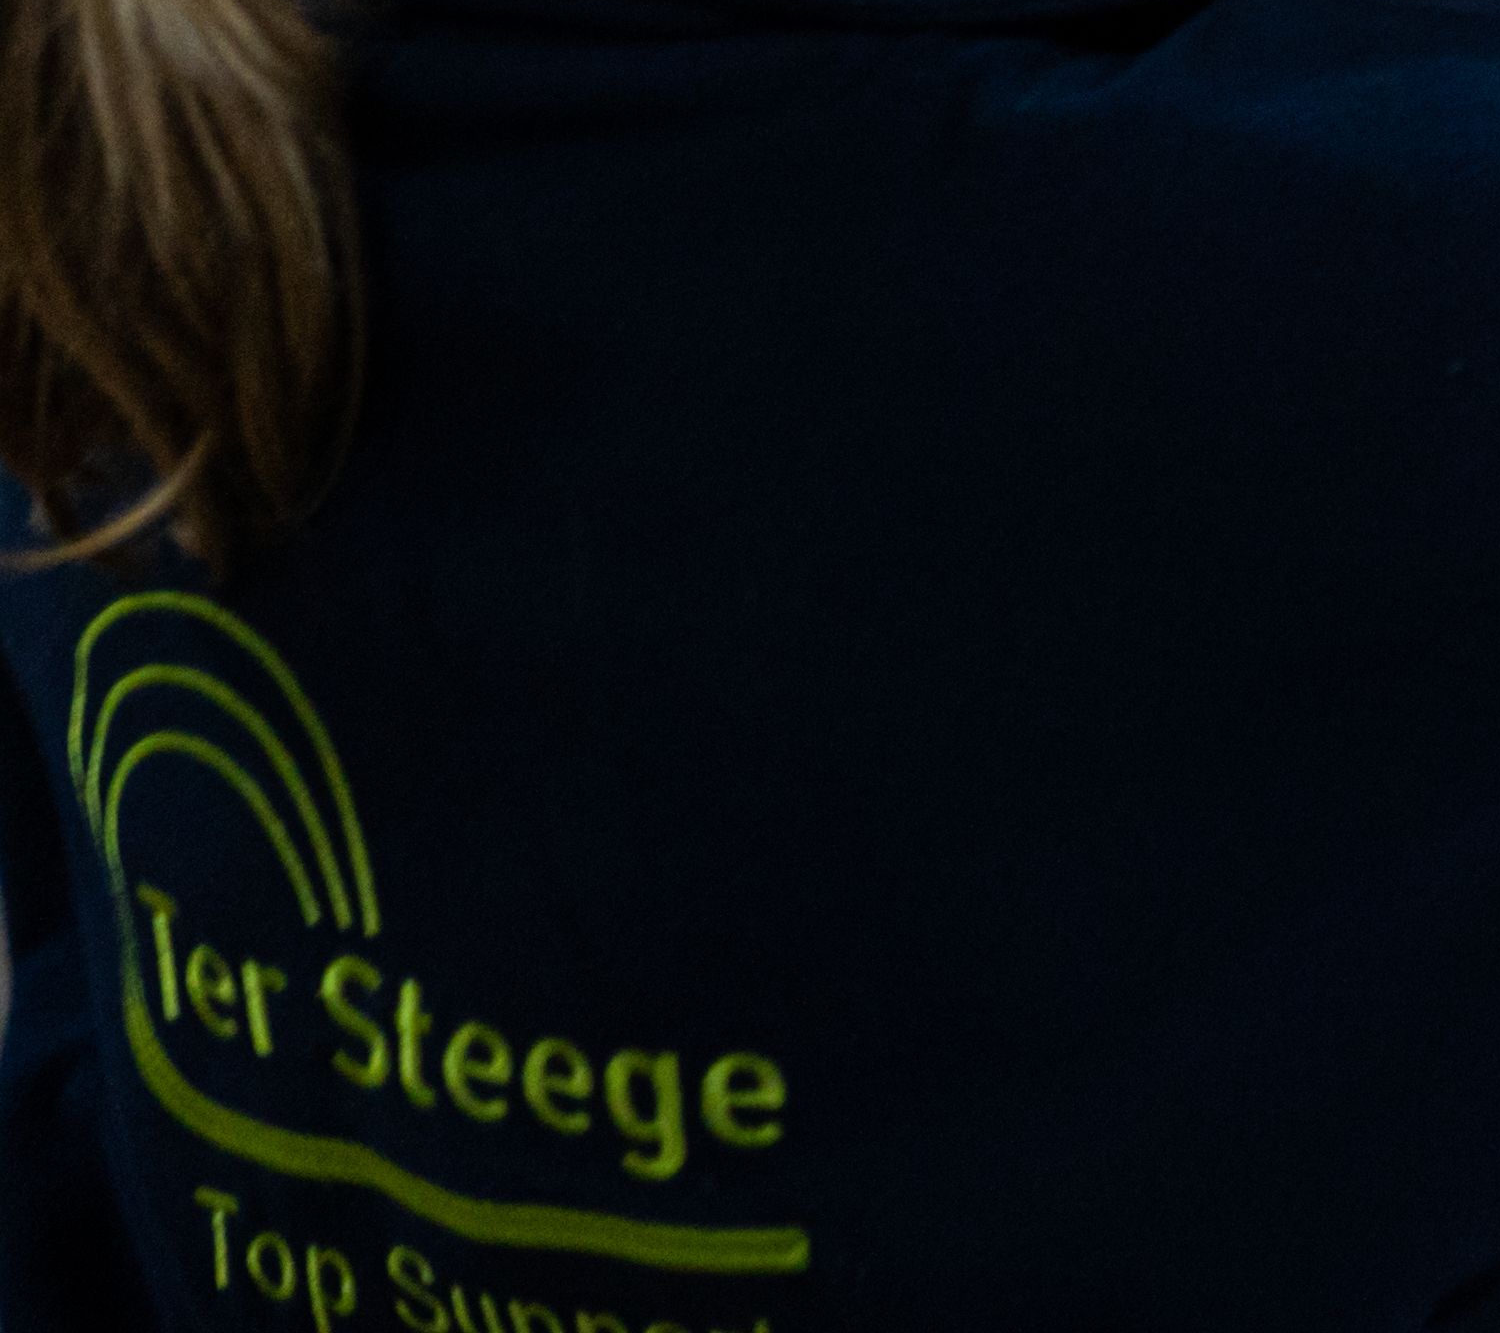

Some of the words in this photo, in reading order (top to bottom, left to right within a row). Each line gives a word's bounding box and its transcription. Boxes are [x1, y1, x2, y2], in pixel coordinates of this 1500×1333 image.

[139, 883, 287, 1057] Ter
[320, 955, 788, 1179] Steege
[197, 1187, 355, 1333] Top
